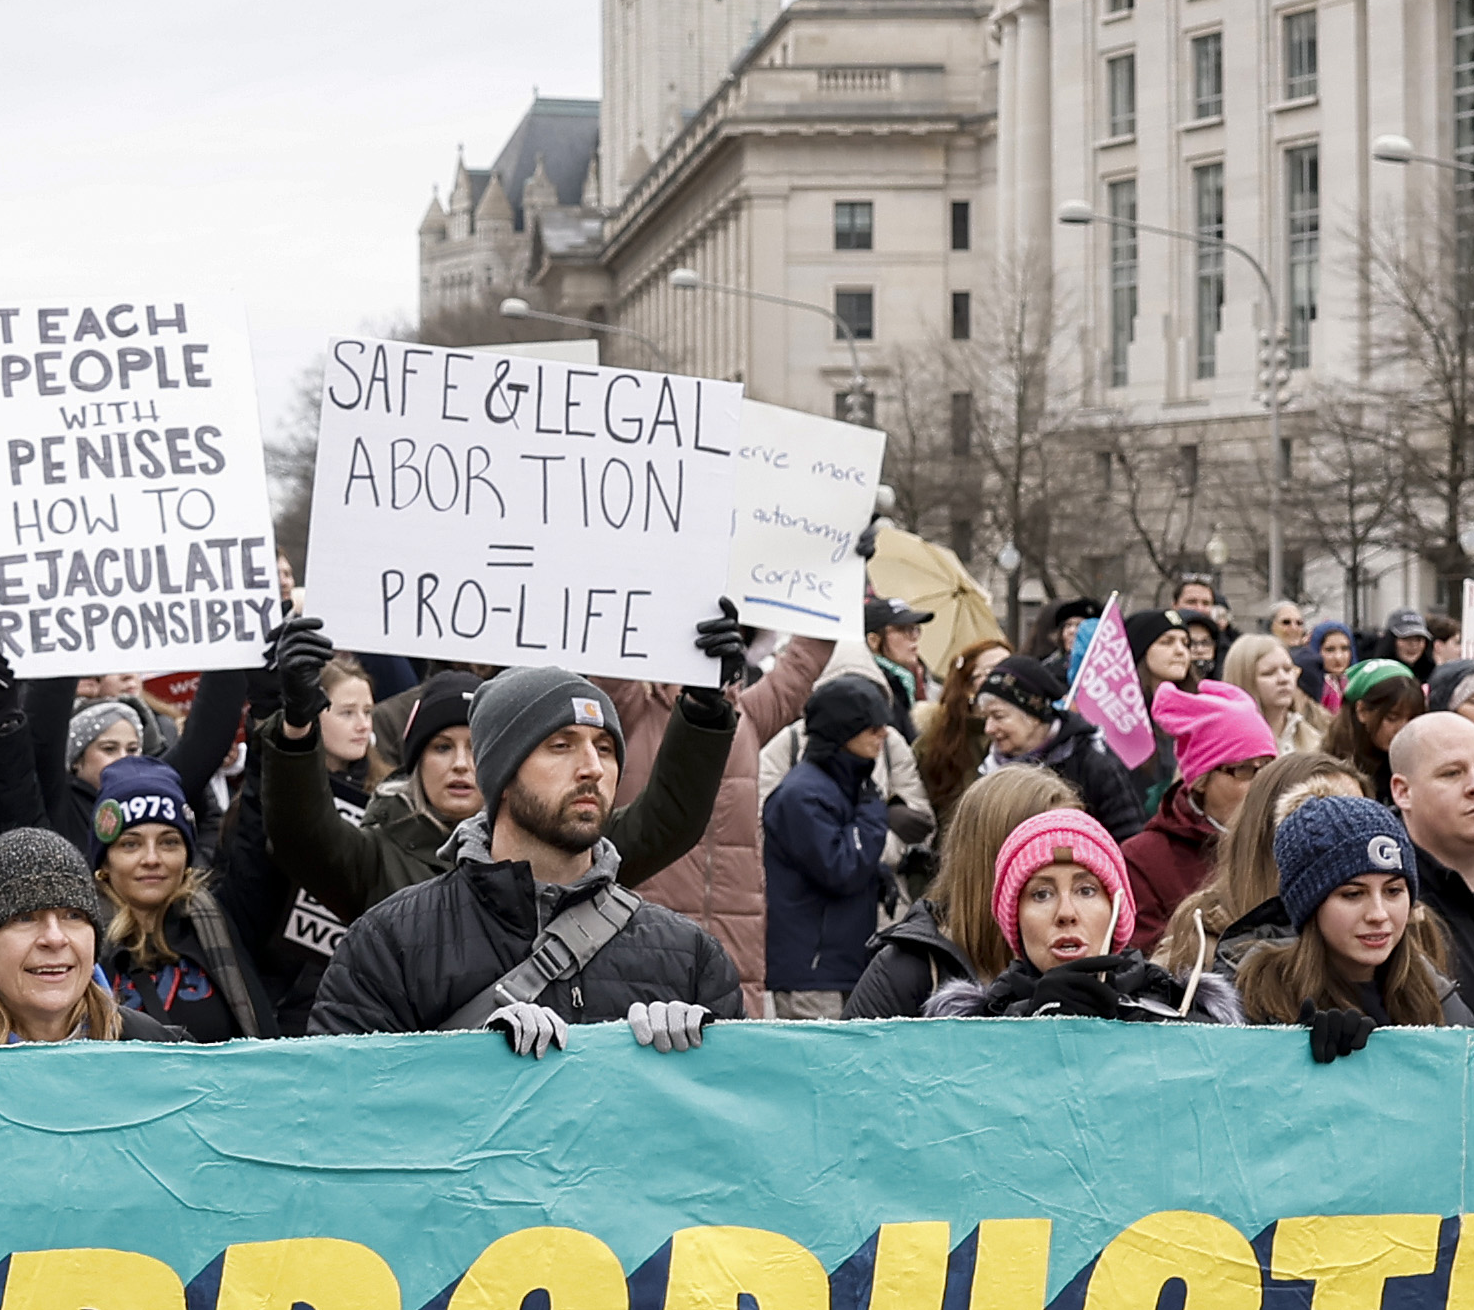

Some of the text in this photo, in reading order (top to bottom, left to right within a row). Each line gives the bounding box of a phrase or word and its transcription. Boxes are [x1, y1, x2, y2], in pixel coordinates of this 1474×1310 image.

[1, 344, 212, 397] PEOPLE
[59, 399, 160, 429] WITH
[8, 425, 226, 486] PENISES
[344, 436, 684, 533] ABORTION
[13, 487, 215, 545] HOW TO
[381, 569, 653, 660] PRO-LIFE
[119, 795, 177, 822] 1973
